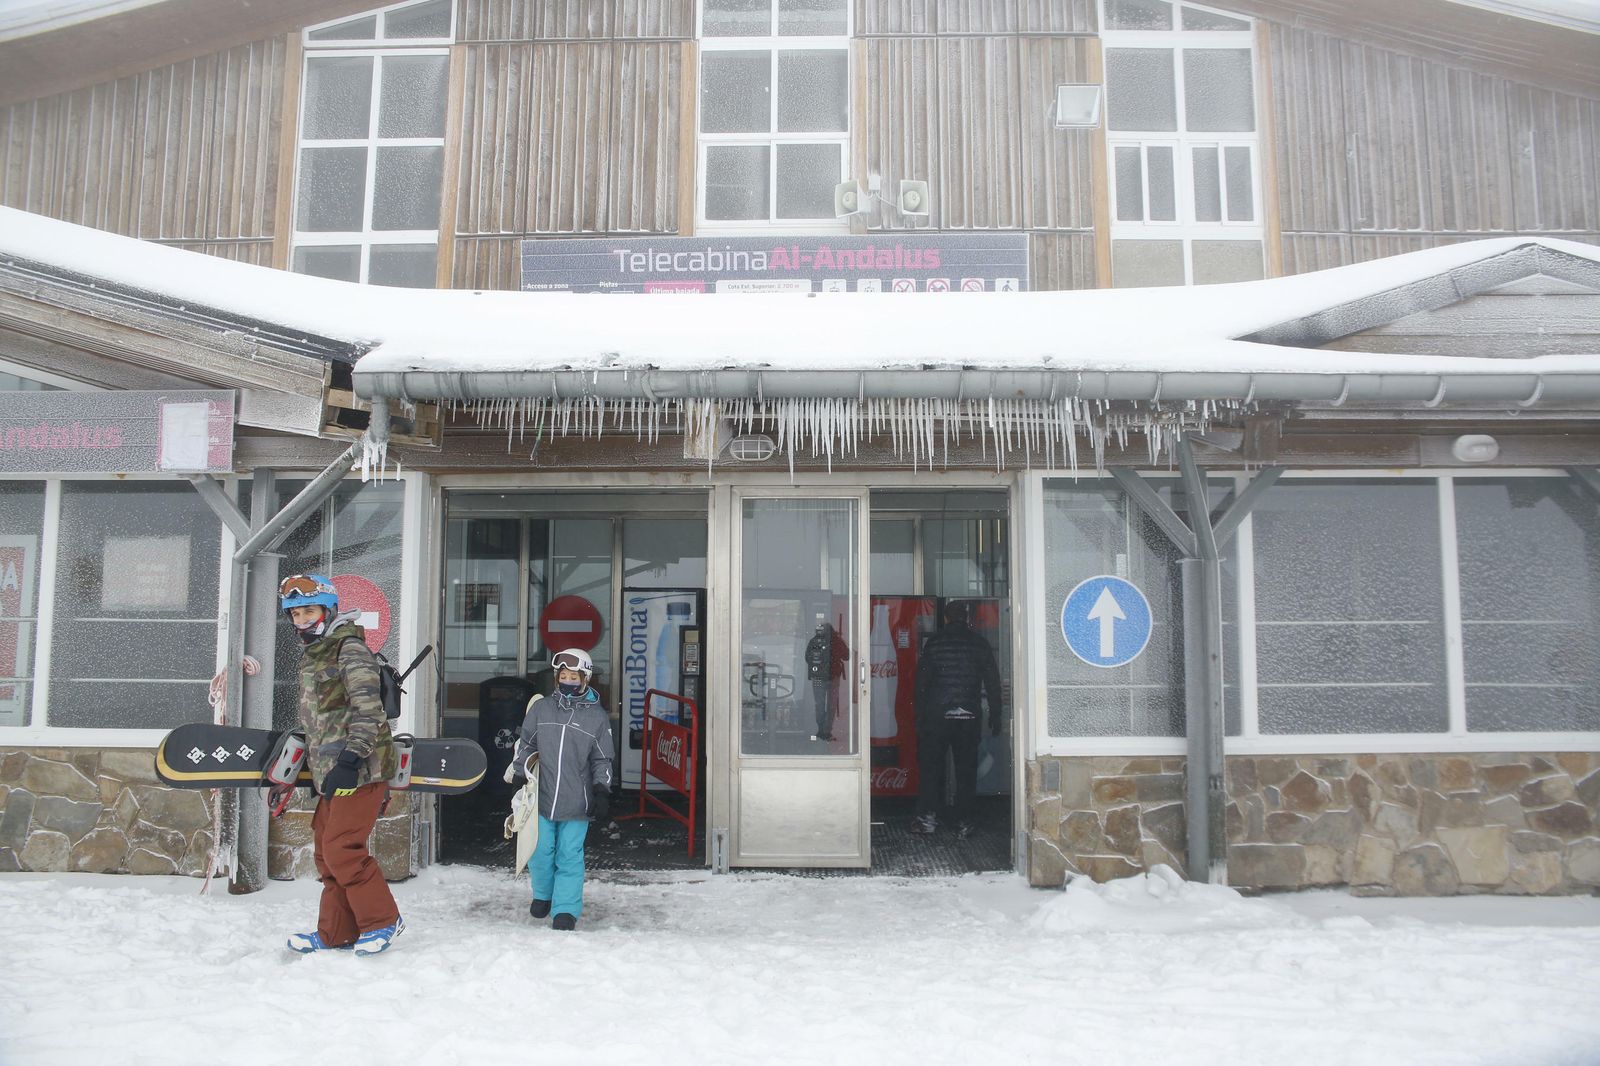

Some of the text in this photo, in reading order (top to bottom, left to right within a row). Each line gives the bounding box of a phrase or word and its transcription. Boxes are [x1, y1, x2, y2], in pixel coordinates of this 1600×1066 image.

[613, 244, 942, 272] Telecabina Al-Andalus
[0, 421, 122, 449] ndalus
